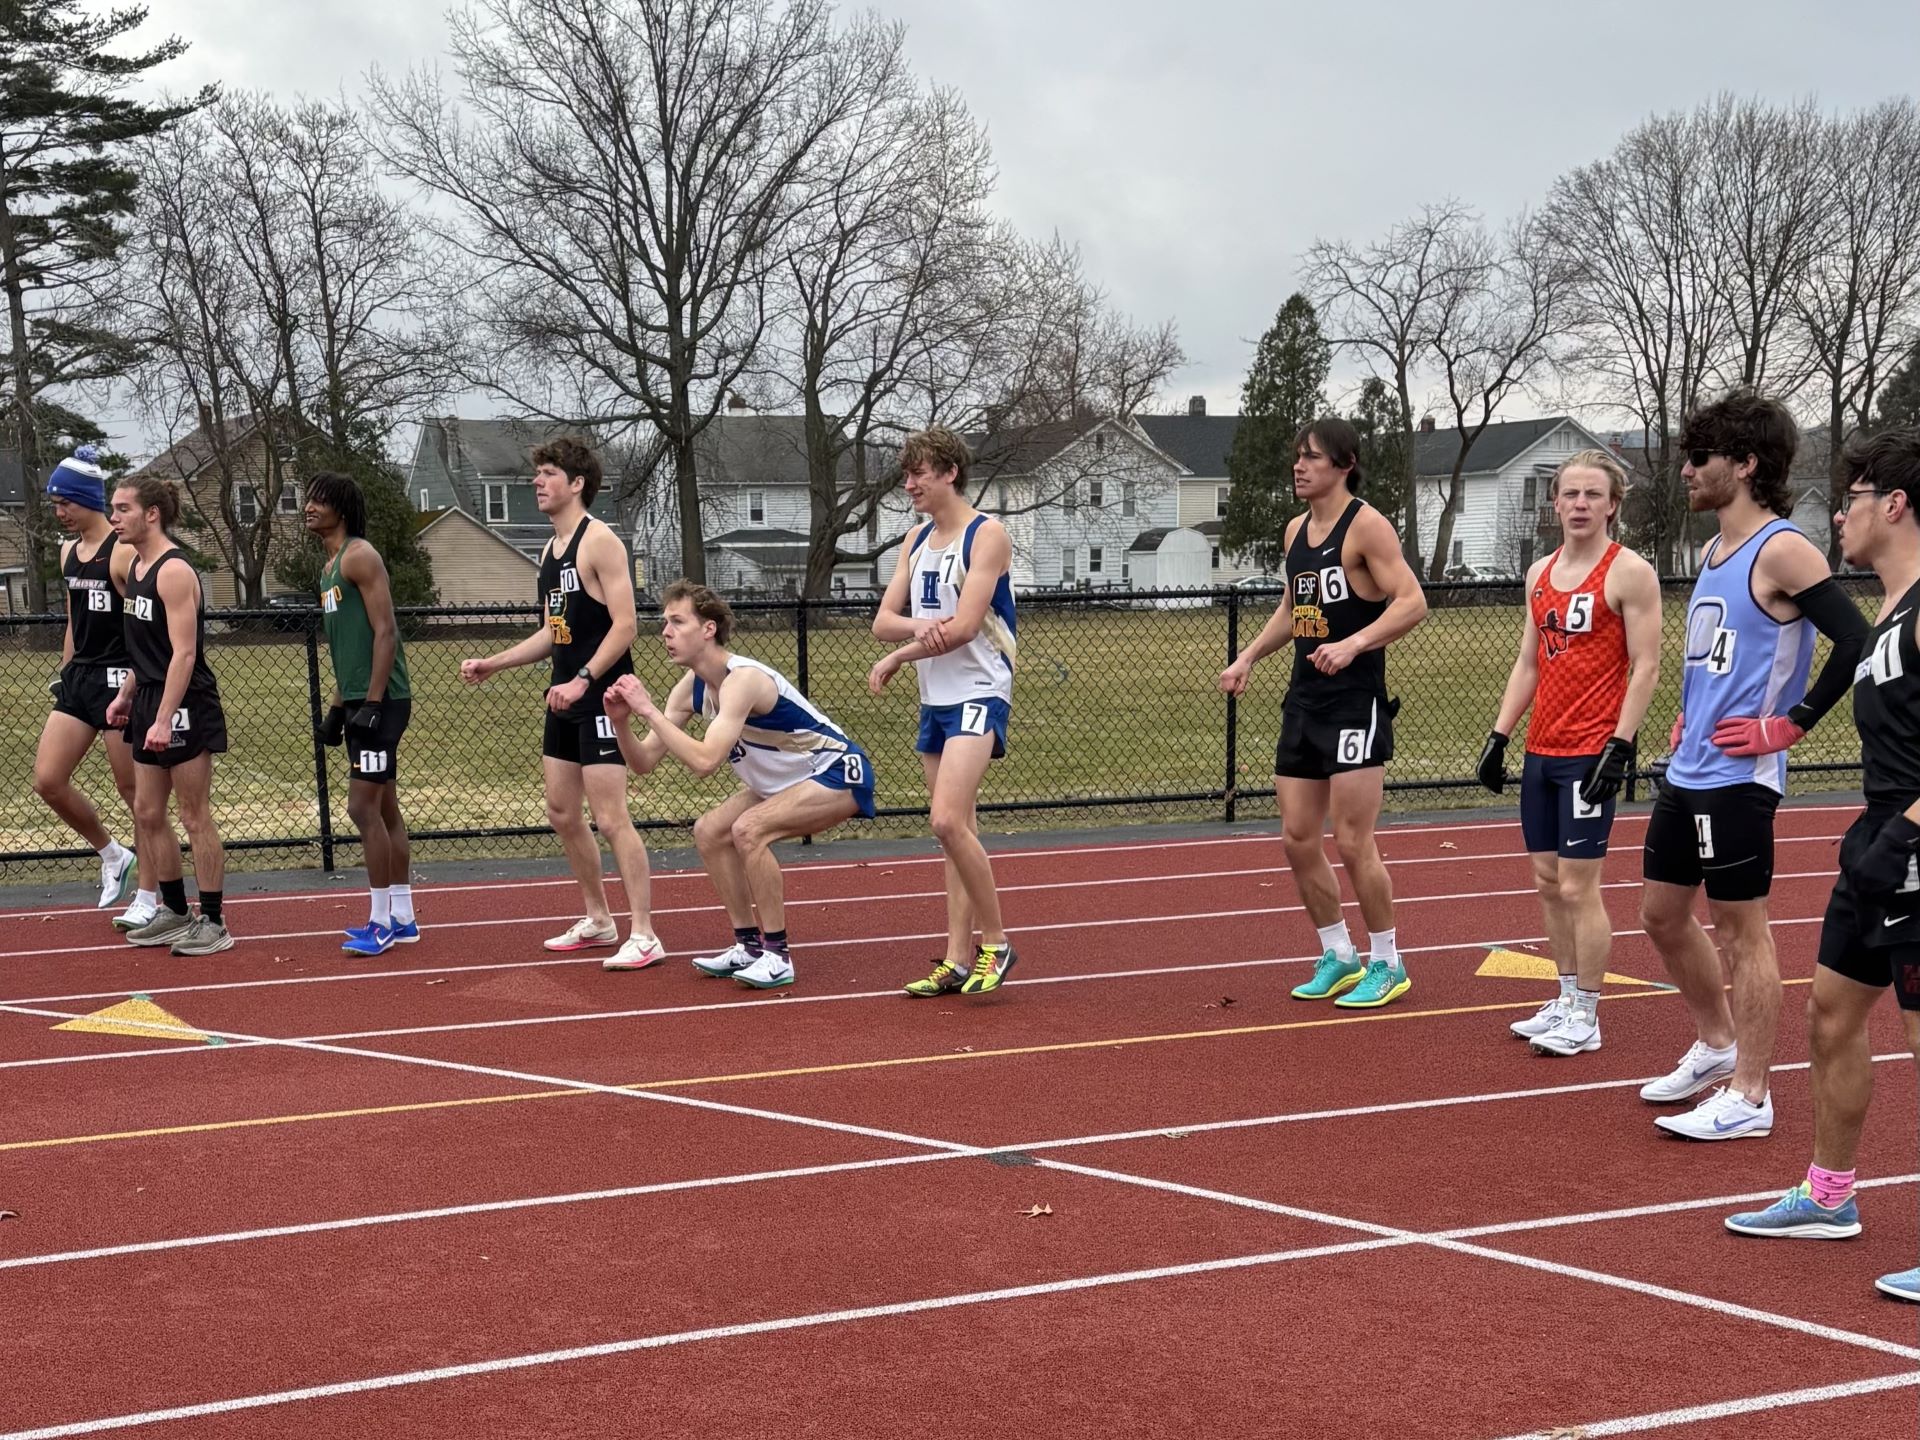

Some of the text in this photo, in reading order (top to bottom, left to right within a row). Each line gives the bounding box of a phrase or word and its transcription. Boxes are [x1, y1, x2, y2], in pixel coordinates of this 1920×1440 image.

[562, 570, 575, 591] 10
[945, 554, 956, 583] 7
[1325, 568, 1342, 600] 6
[91, 592, 106, 611] 13
[138, 598, 149, 619] 12
[1571, 596, 1589, 630] 5
[1292, 618, 1330, 638] AKS
[1711, 631, 1728, 671] 4
[1880, 631, 1893, 678] 1
[969, 704, 983, 730] 7
[1343, 731, 1359, 762] 6
[362, 751, 381, 771] 11
[847, 756, 861, 782] 8
